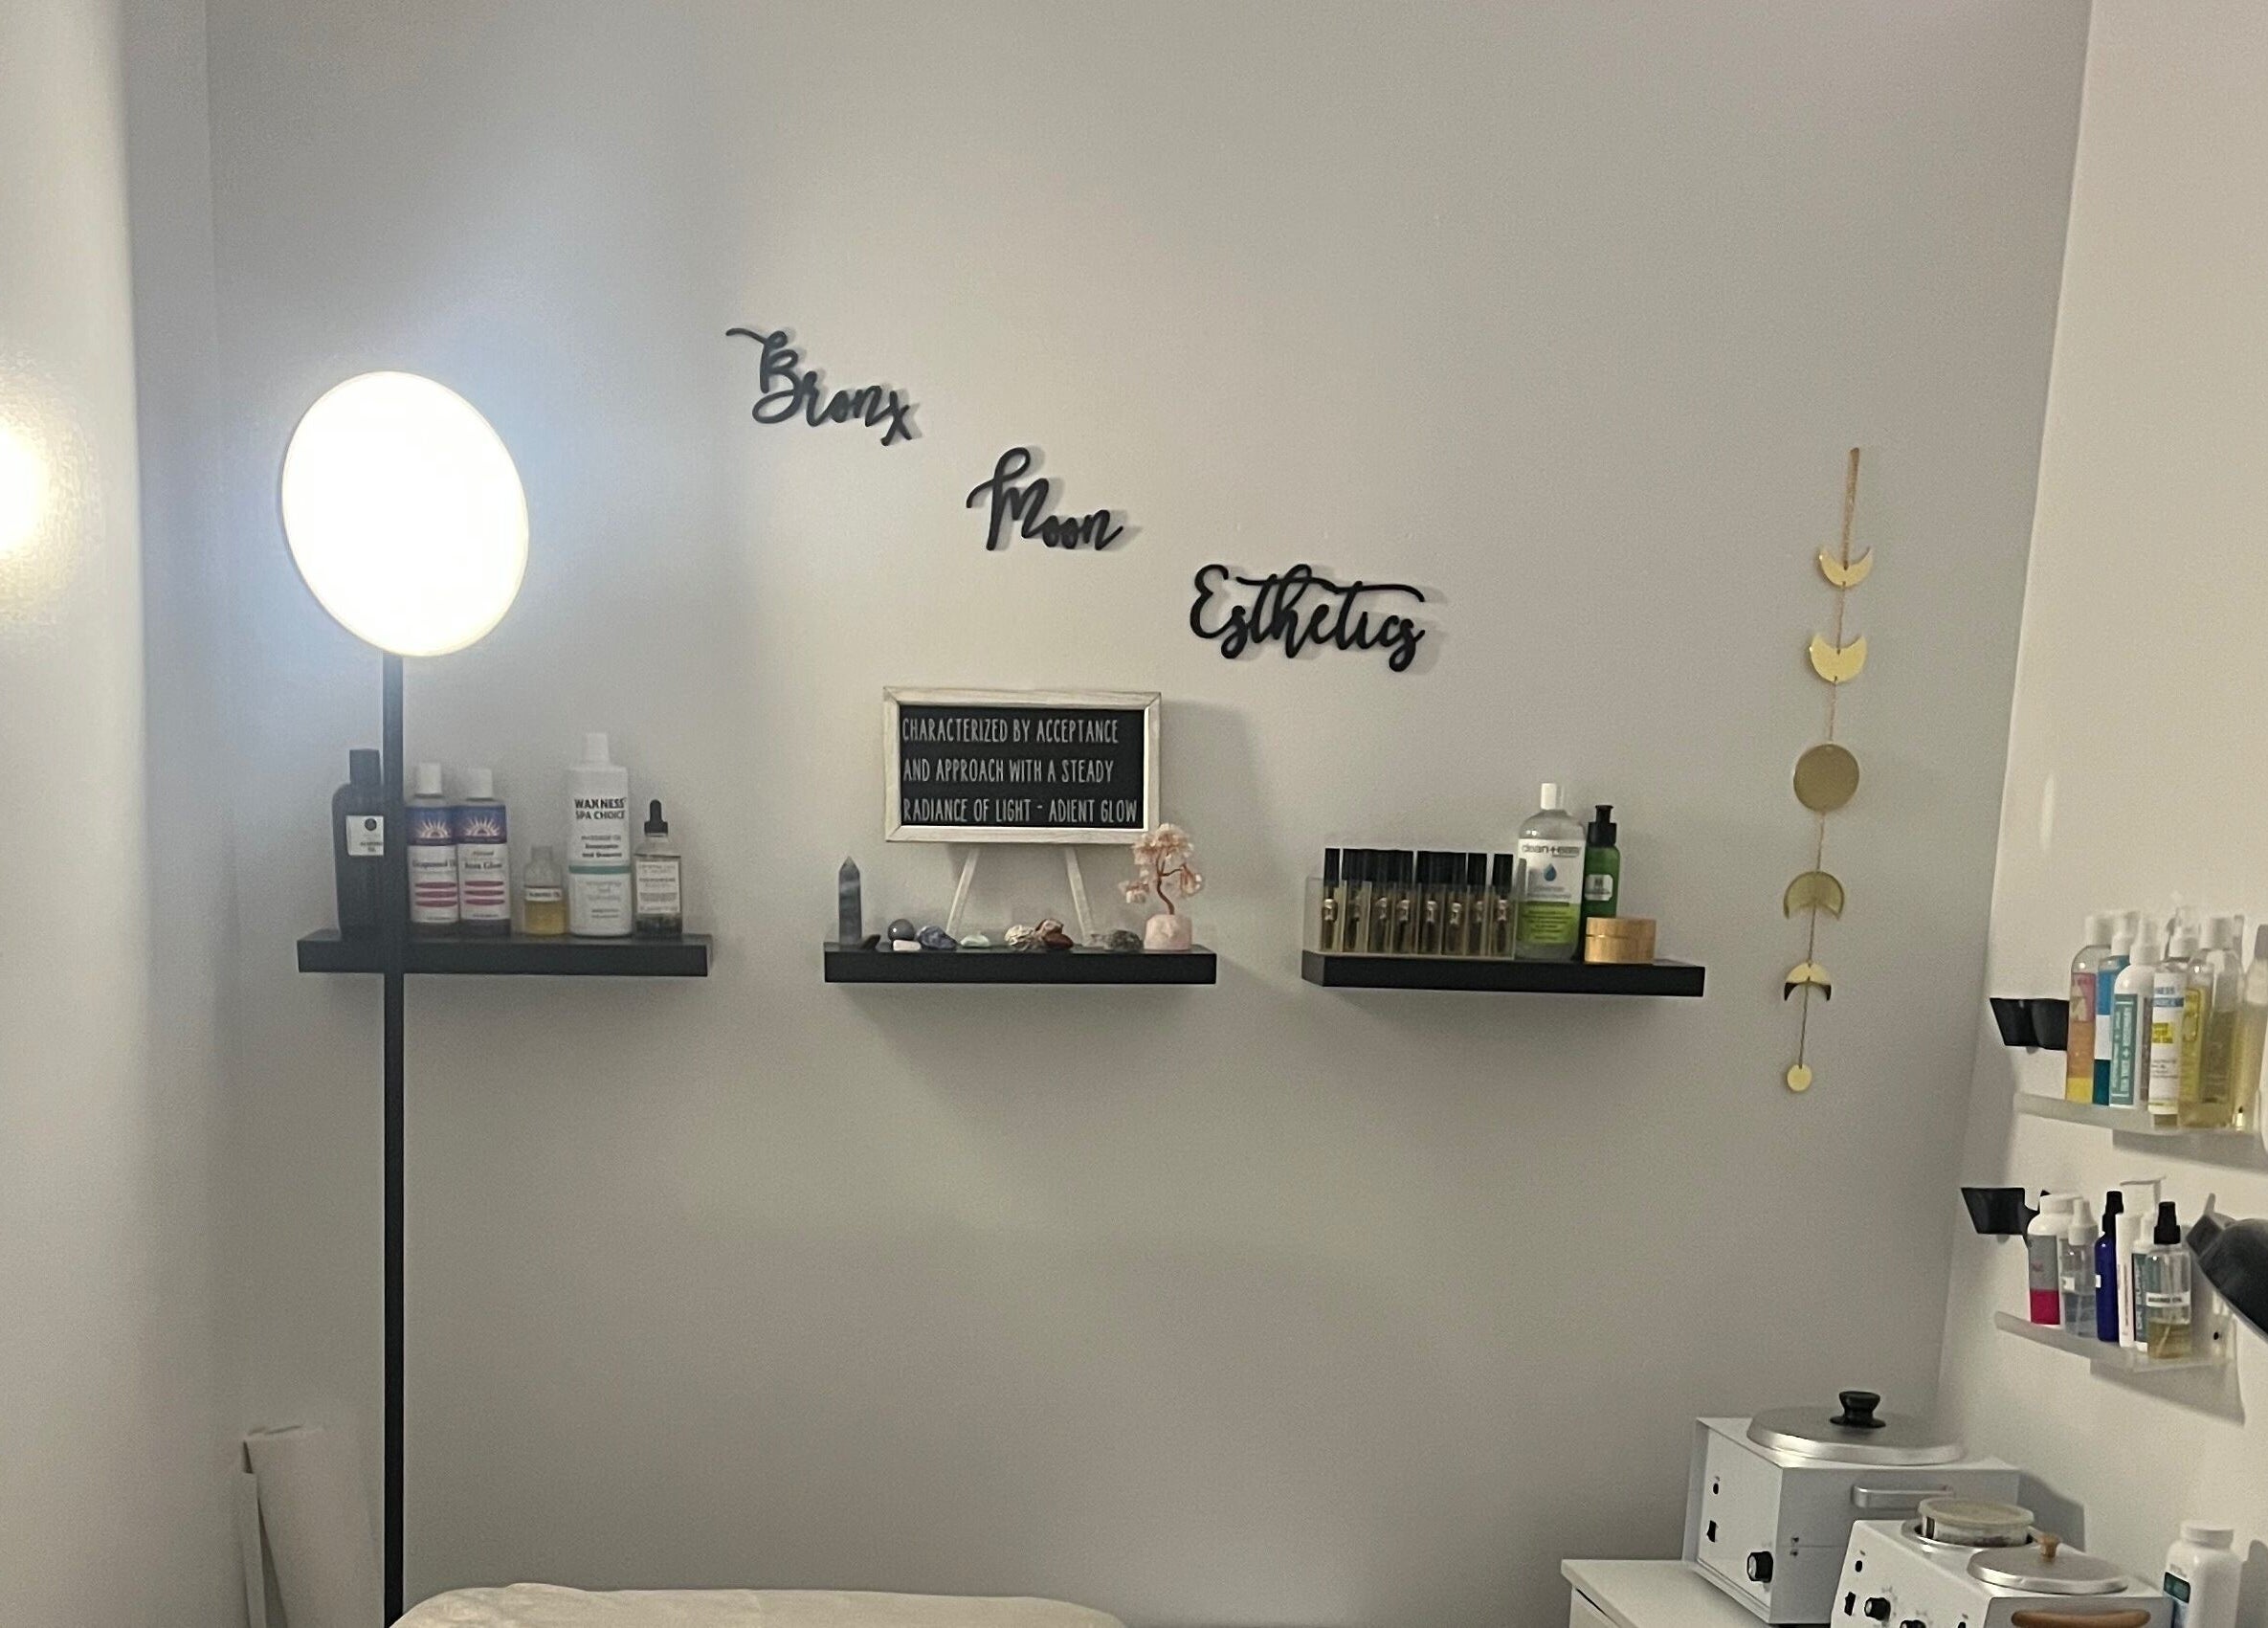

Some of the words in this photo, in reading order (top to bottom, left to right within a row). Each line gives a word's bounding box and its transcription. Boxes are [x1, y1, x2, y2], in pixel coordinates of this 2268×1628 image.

[726, 328, 913, 446] Bronx
[966, 446, 1123, 551] Moon
[1190, 563, 1426, 672] Esthetics
[901, 718, 1008, 743] CHARACTERIZED
[1012, 719, 1031, 743] BY
[1036, 720, 1120, 744] ACCEPTANCE
[902, 758, 930, 782] AND
[936, 758, 1004, 783] APPROACH
[1009, 759, 1042, 783] WITH
[1047, 760, 1056, 782] A
[1061, 760, 1114, 783] STEADY
[574, 797, 625, 809] WAXNESS
[575, 810, 592, 820] SPA
[593, 810, 626, 820] CHOICE
[902, 798, 968, 822] RADIANCE
[973, 798, 989, 822] OF
[995, 799, 1032, 823] LIGHT
[1048, 799, 1096, 823] ADIENT
[1101, 800, 1138, 823] GLOW
